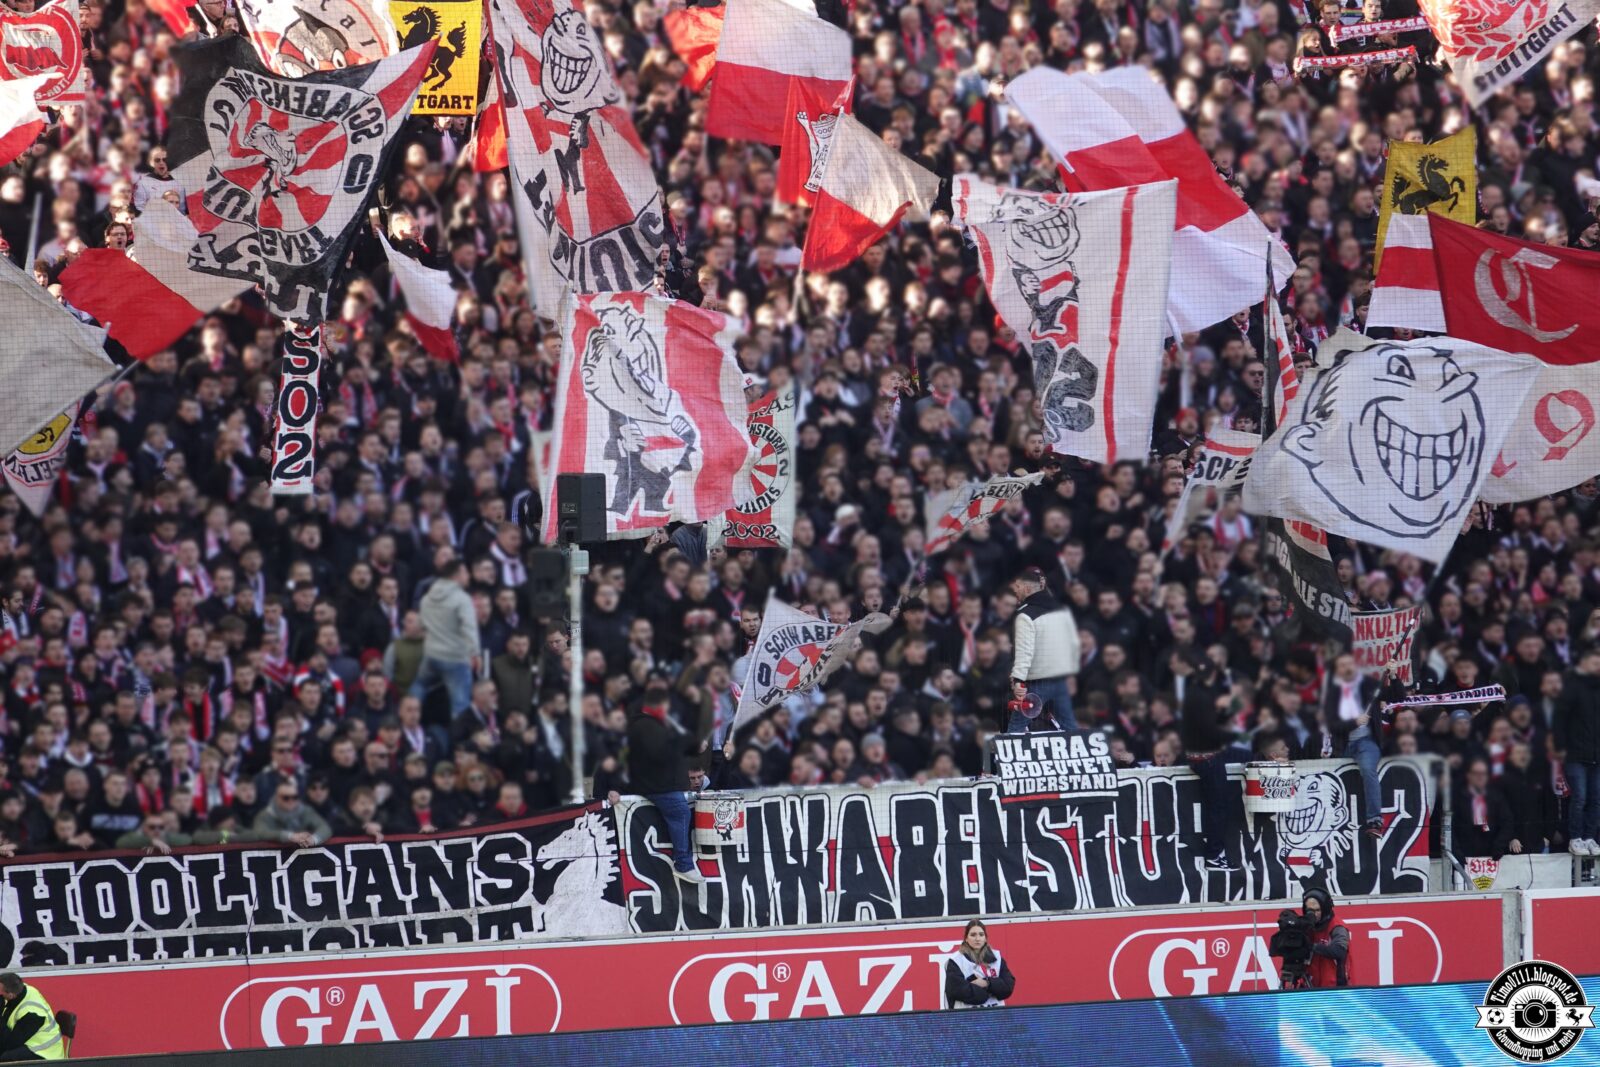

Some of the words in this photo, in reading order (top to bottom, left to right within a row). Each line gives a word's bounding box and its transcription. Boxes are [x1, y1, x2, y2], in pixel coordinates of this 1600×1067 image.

[1341, 16, 1427, 35] STUTTGA
[1473, 2, 1577, 92] STUTTGART
[416, 95, 474, 109] TGART
[748, 422, 788, 456] NSTURM
[735, 486, 781, 514] STUTT
[764, 625, 836, 661] SCHWABE
[995, 732, 1109, 763] ULTRAS
[1000, 756, 1112, 780] BEDEUTET
[1002, 773, 1118, 796] WIDERSTAND
[6, 832, 533, 938] HOOLIGANS
